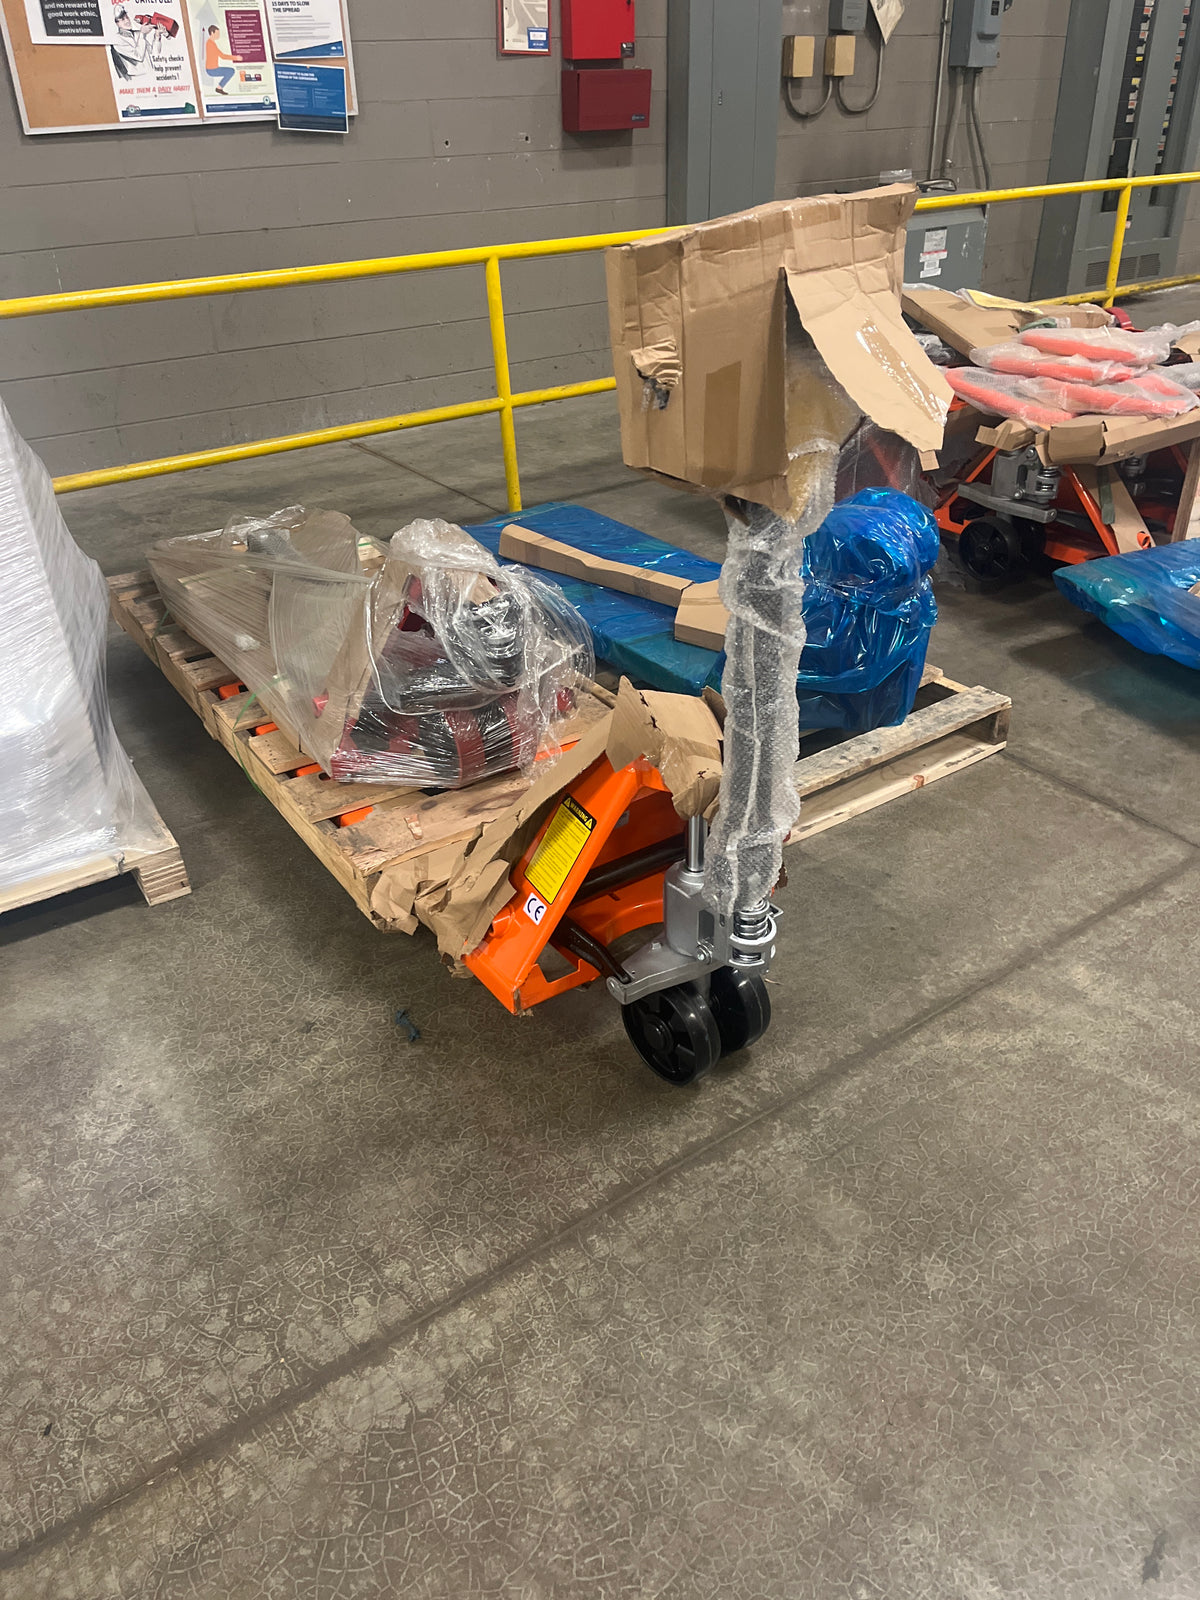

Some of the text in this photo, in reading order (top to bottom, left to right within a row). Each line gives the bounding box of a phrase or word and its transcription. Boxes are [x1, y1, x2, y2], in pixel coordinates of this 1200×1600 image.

[47, 11, 63, 19] good
[152, 54, 184, 63] Safety checks
[153, 65, 182, 73] help prevent
[156, 73, 180, 81] accidents!
